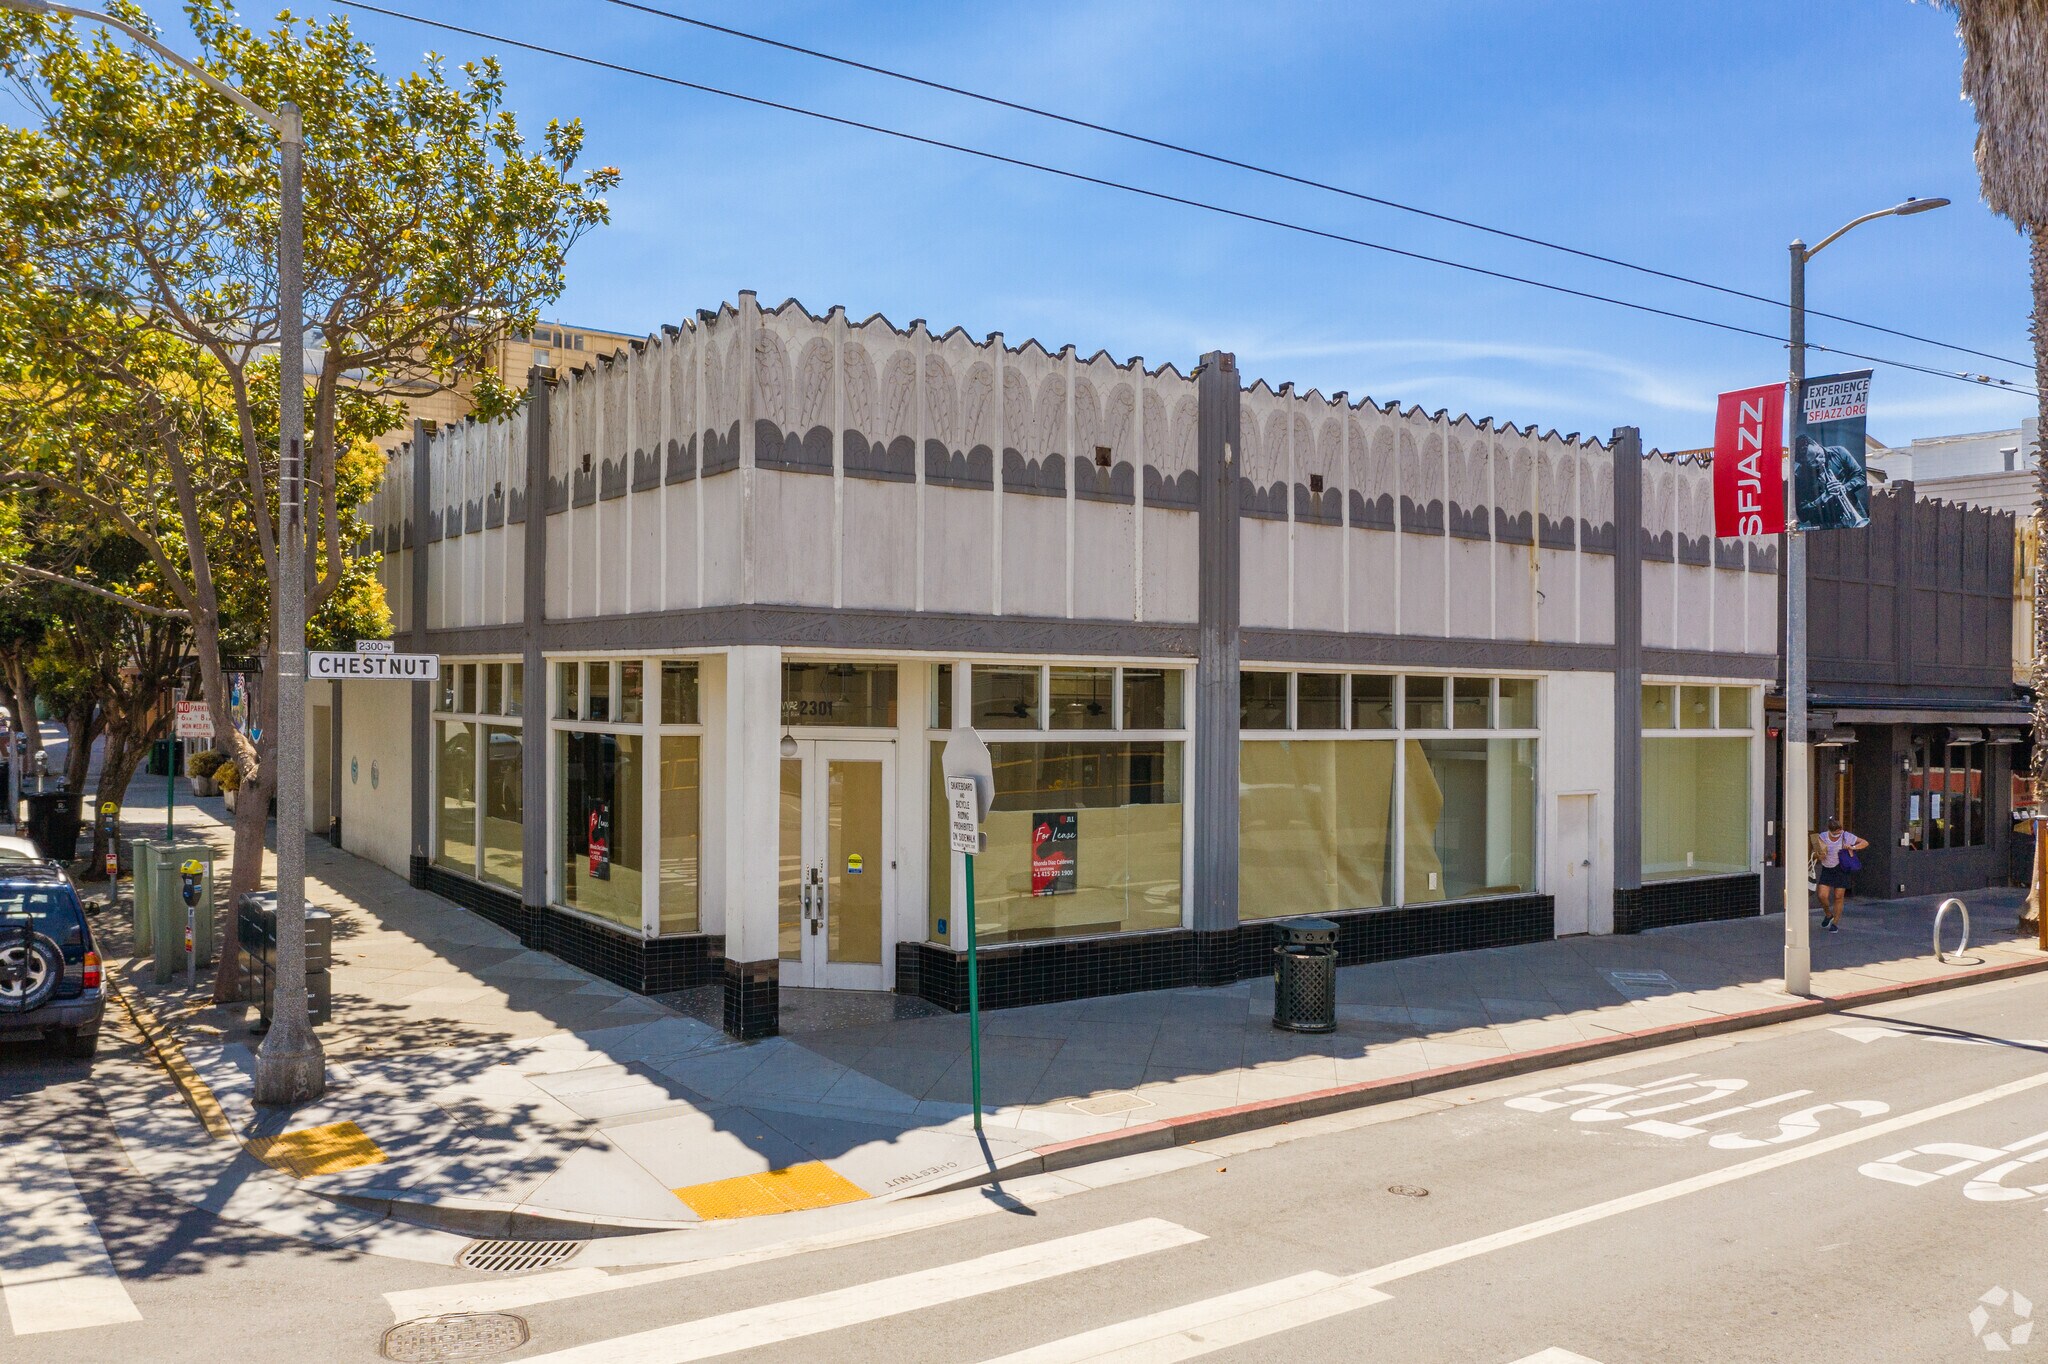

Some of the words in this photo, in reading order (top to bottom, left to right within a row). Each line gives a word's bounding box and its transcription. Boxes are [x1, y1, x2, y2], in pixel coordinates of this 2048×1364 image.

[1809, 380, 1869, 398] EXPERIENCE
[1805, 398, 1826, 411] LIVE
[1829, 394, 1852, 408] JAZZ
[1854, 391, 1868, 403] AT
[1808, 404, 1866, 422] SFJAZZ.ORG
[1738, 397, 1764, 536] SFJAZZ
[359, 642, 384, 651] 2300
[318, 657, 430, 676] CHESTNUT
[178, 702, 189, 712] NO
[800, 701, 833, 717] 2301
[951, 782, 973, 791] SKATEBOARD
[956, 800, 970, 809] BICYCLE
[958, 811, 969, 820] RIDING
[954, 822, 974, 832] PROHIBITED
[1036, 827, 1050, 842] For
[1052, 827, 1077, 842] Lease
[953, 832, 957, 840] ON
[959, 833, 976, 843] SIDEWALK
[885, 1161, 958, 1188] CHESTNUT
